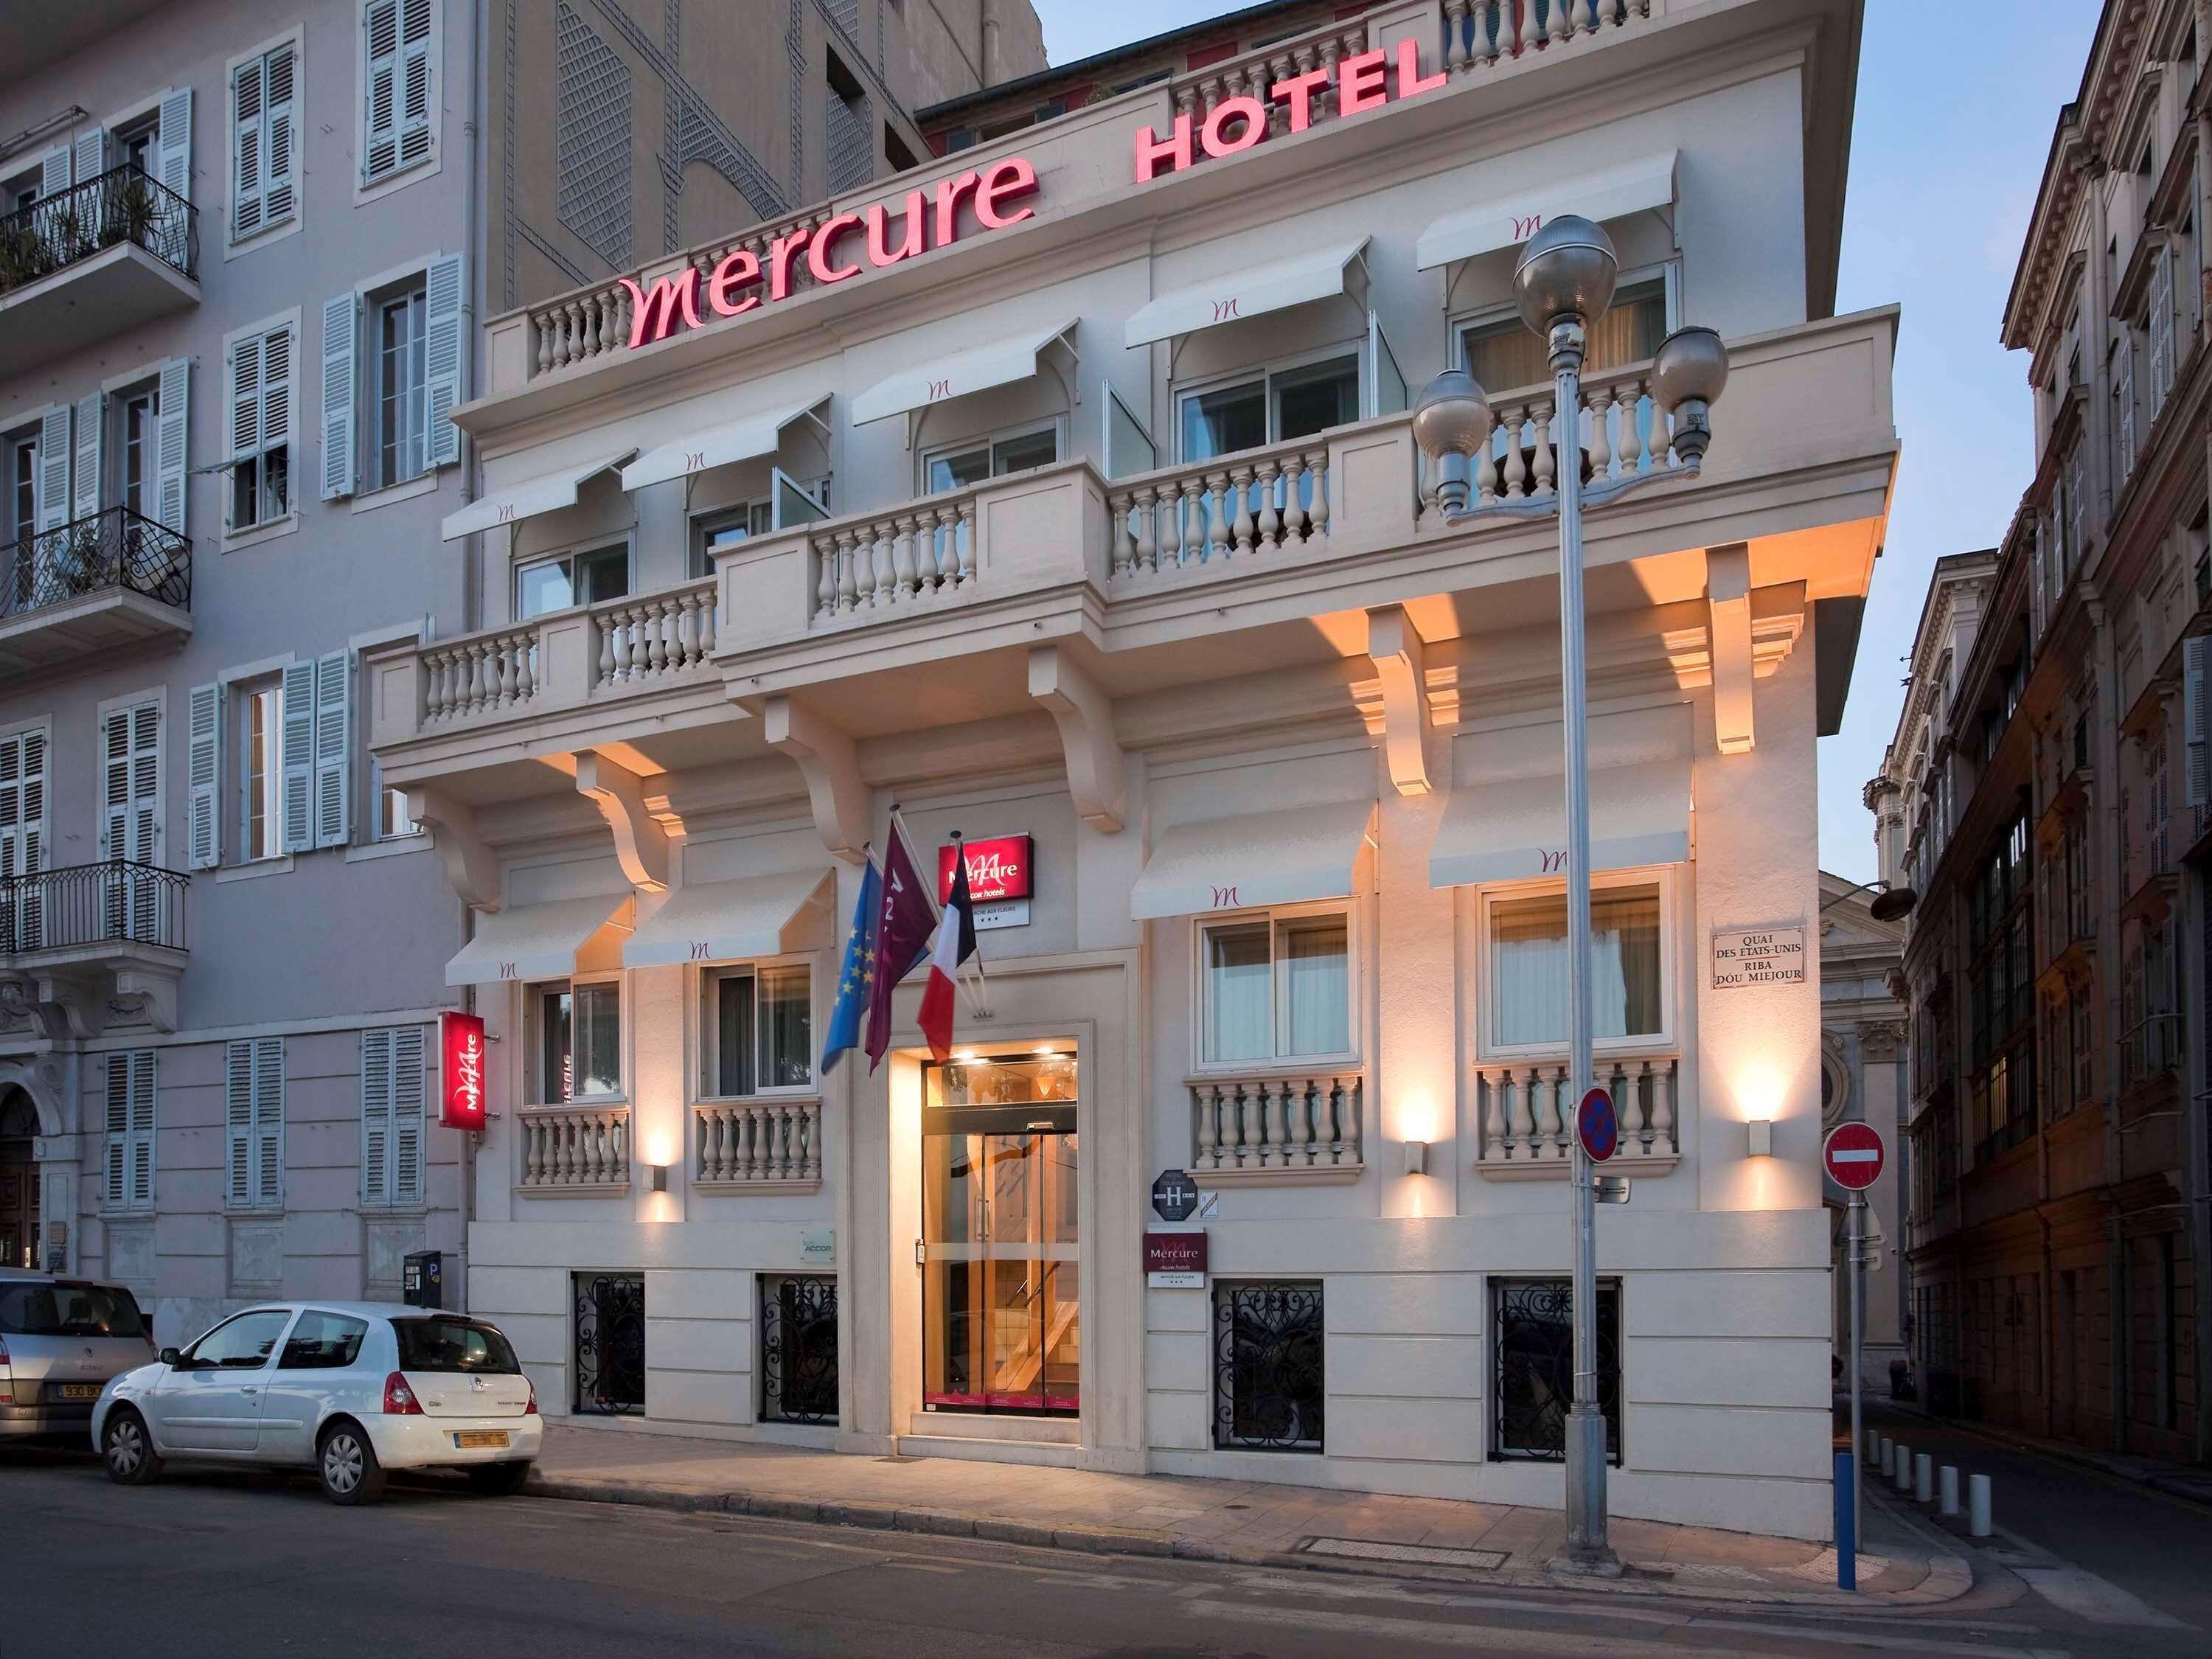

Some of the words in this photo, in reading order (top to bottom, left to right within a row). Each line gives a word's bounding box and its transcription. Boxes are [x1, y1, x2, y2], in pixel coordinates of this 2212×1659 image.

[1135, 39, 1447, 183] HOTEL
[984, 887, 1006, 898] hotels
[1742, 935, 1773, 946] QUAI
[1717, 948, 1736, 959] DES
[1740, 943, 1801, 956] ETATS-UNIS
[1745, 961, 1772, 971] RIBA
[1748, 970, 1802, 981] MIEJOUR
[467, 1034, 477, 1110] Mercure
[1167, 1186, 1181, 1206] H
[1150, 1249, 1198, 1258] Mercure
[430, 1263, 437, 1276] P
